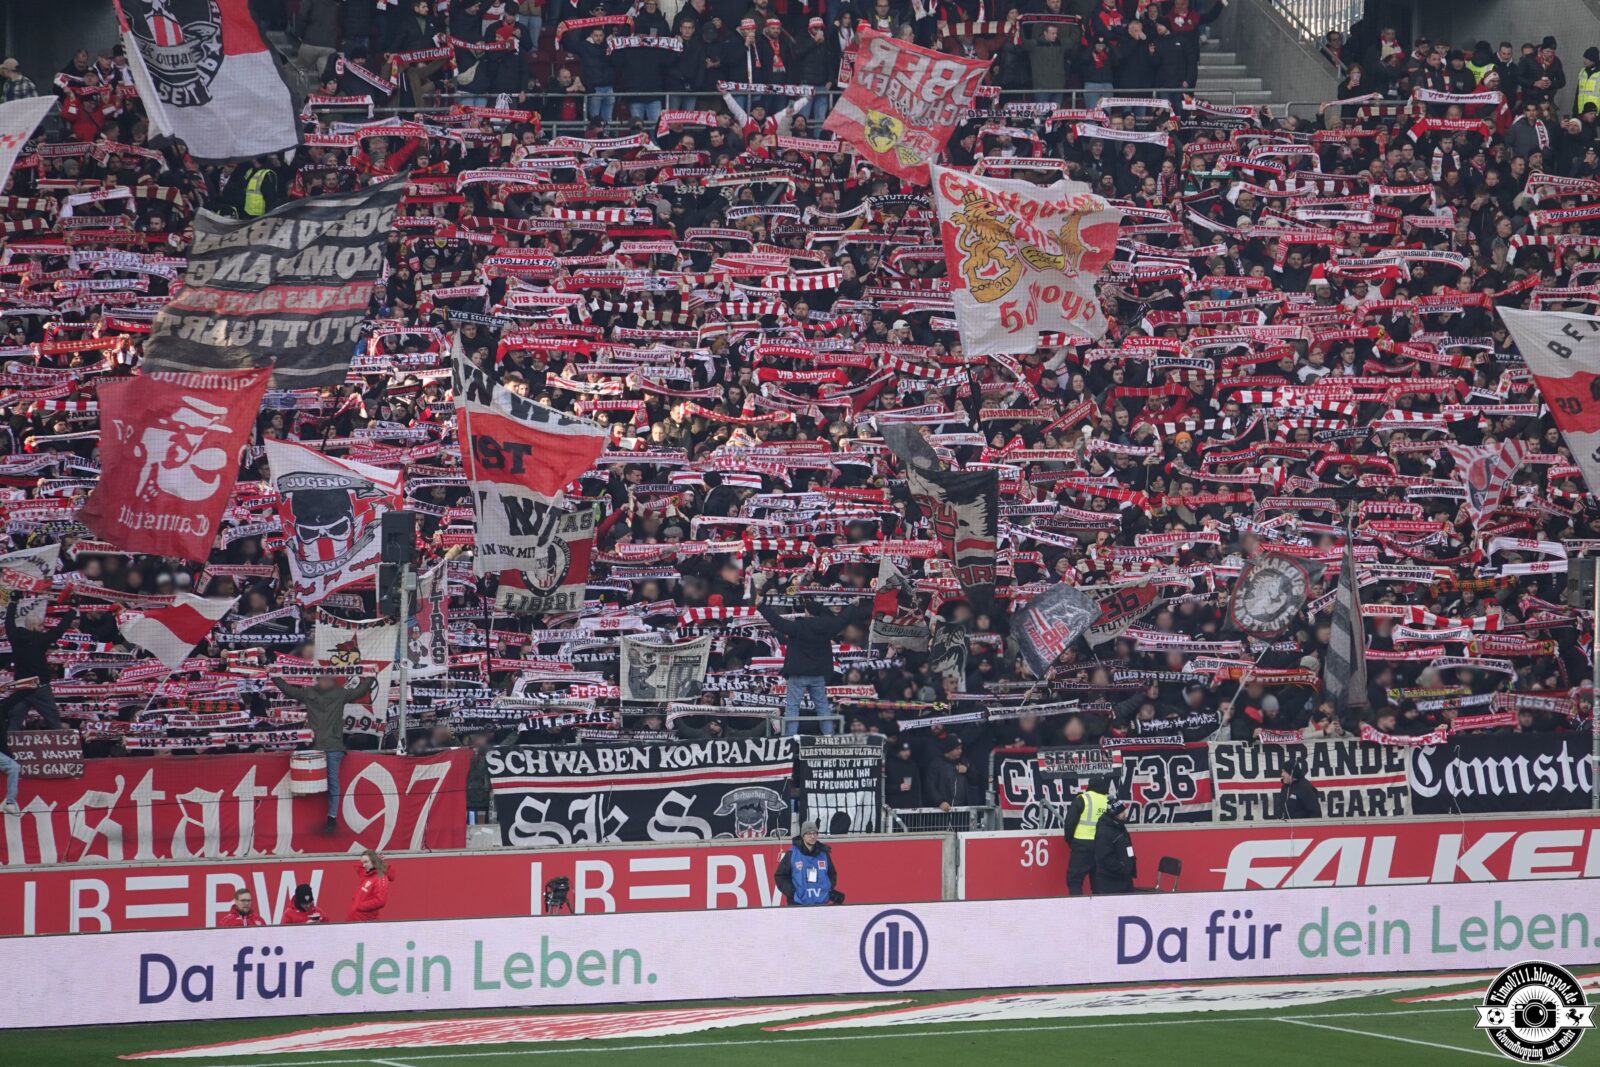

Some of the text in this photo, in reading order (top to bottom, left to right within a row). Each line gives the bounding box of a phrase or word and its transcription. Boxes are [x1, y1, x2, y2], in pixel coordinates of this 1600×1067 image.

[1427, 118, 1482, 128] VfB Stuttgart
[530, 183, 585, 192] STUTTGART
[1550, 210, 1564, 219] VfB
[623, 242, 673, 251] VfB Stuttgart
[891, 288, 950, 298] STUTTGART
[511, 295, 580, 305] VfB Stuttgart
[451, 311, 469, 320] VfB
[504, 337, 578, 348] VfB Stuttgart
[616, 350, 670, 360] VfB Stuttgart
[777, 370, 836, 381] VfB Stuttgart
[287, 476, 350, 488] JUGEND
[281, 665, 364, 676] COMMANDO
[1113, 671, 1138, 681] ALLES
[1516, 697, 1555, 711] 1893
[55, 733, 80, 746] IST
[815, 736, 841, 746] EHRE
[42, 750, 83, 760] KAMPF
[485, 736, 795, 776] SCHWABEN KOMPANIE
[854, 747, 882, 757] ULTRAS
[1214, 739, 1405, 781] SÜDBANDE
[43, 763, 84, 776] GANZE
[812, 768, 871, 779] WENN MAN IHN
[805, 779, 818, 790] MIT
[819, 778, 859, 790] FREUNDEN
[343, 761, 452, 854] 97
[1020, 839, 1049, 868] 36
[806, 888, 821, 898] TV
[1116, 915, 1188, 965] Da
[1205, 908, 1283, 962] für
[1297, 905, 1411, 958] dein
[139, 935, 658, 1004] Da für dein Leben.
